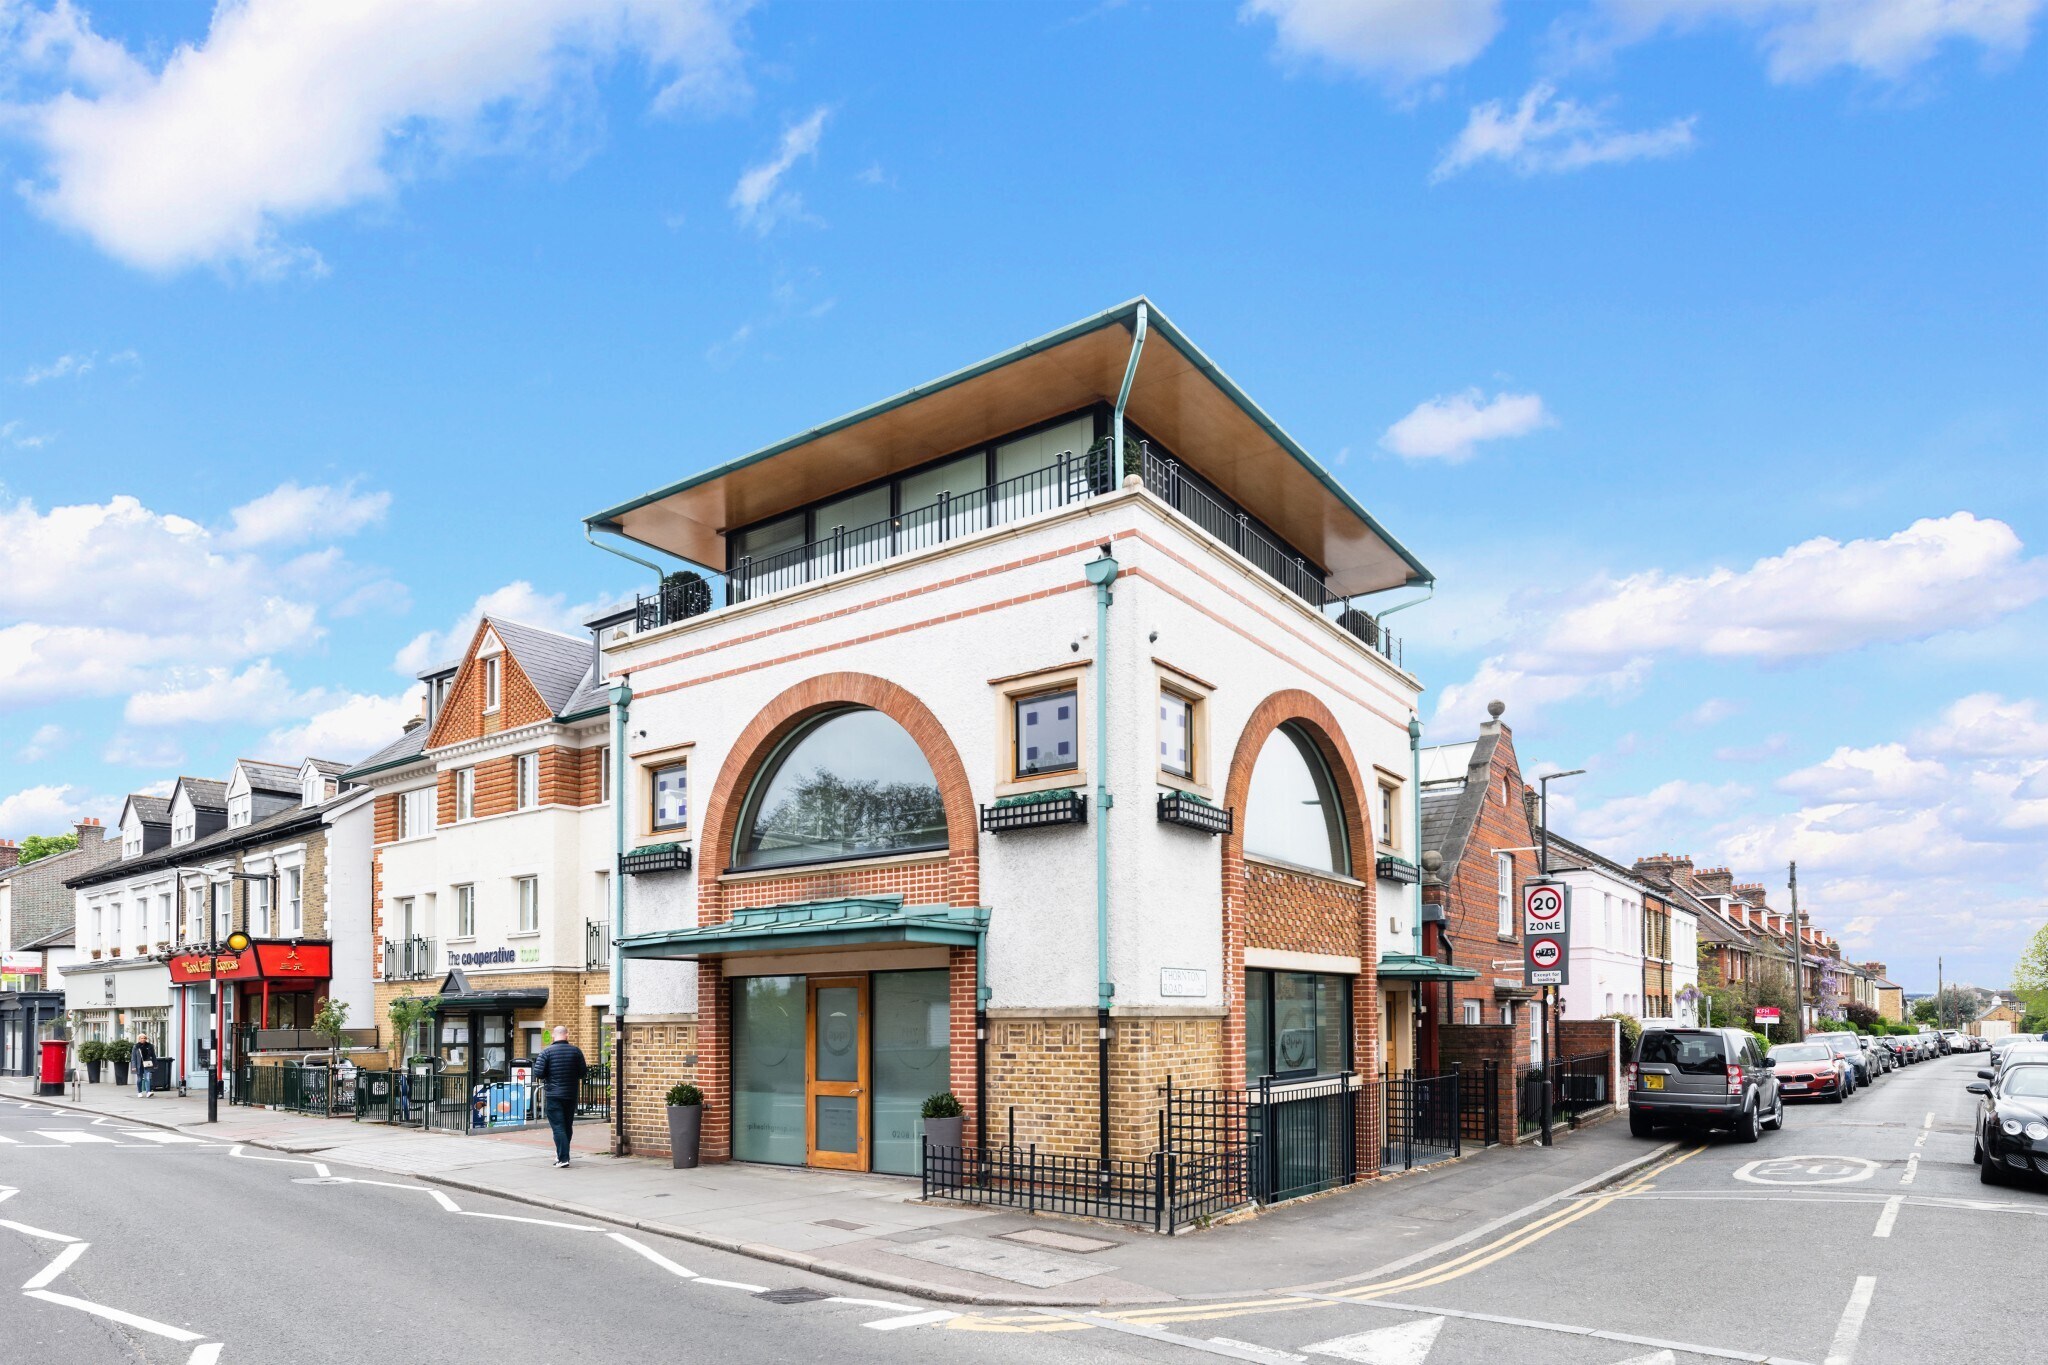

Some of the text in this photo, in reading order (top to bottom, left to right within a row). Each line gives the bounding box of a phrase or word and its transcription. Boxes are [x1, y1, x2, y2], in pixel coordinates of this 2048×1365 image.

[1533, 896, 1557, 911] 20
[1529, 921, 1561, 931] ZONE
[447, 950, 460, 966] The
[1163, 970, 1201, 982] THORNTON
[1163, 983, 1183, 994] ROAD
[1756, 1161, 1854, 1175] 20
